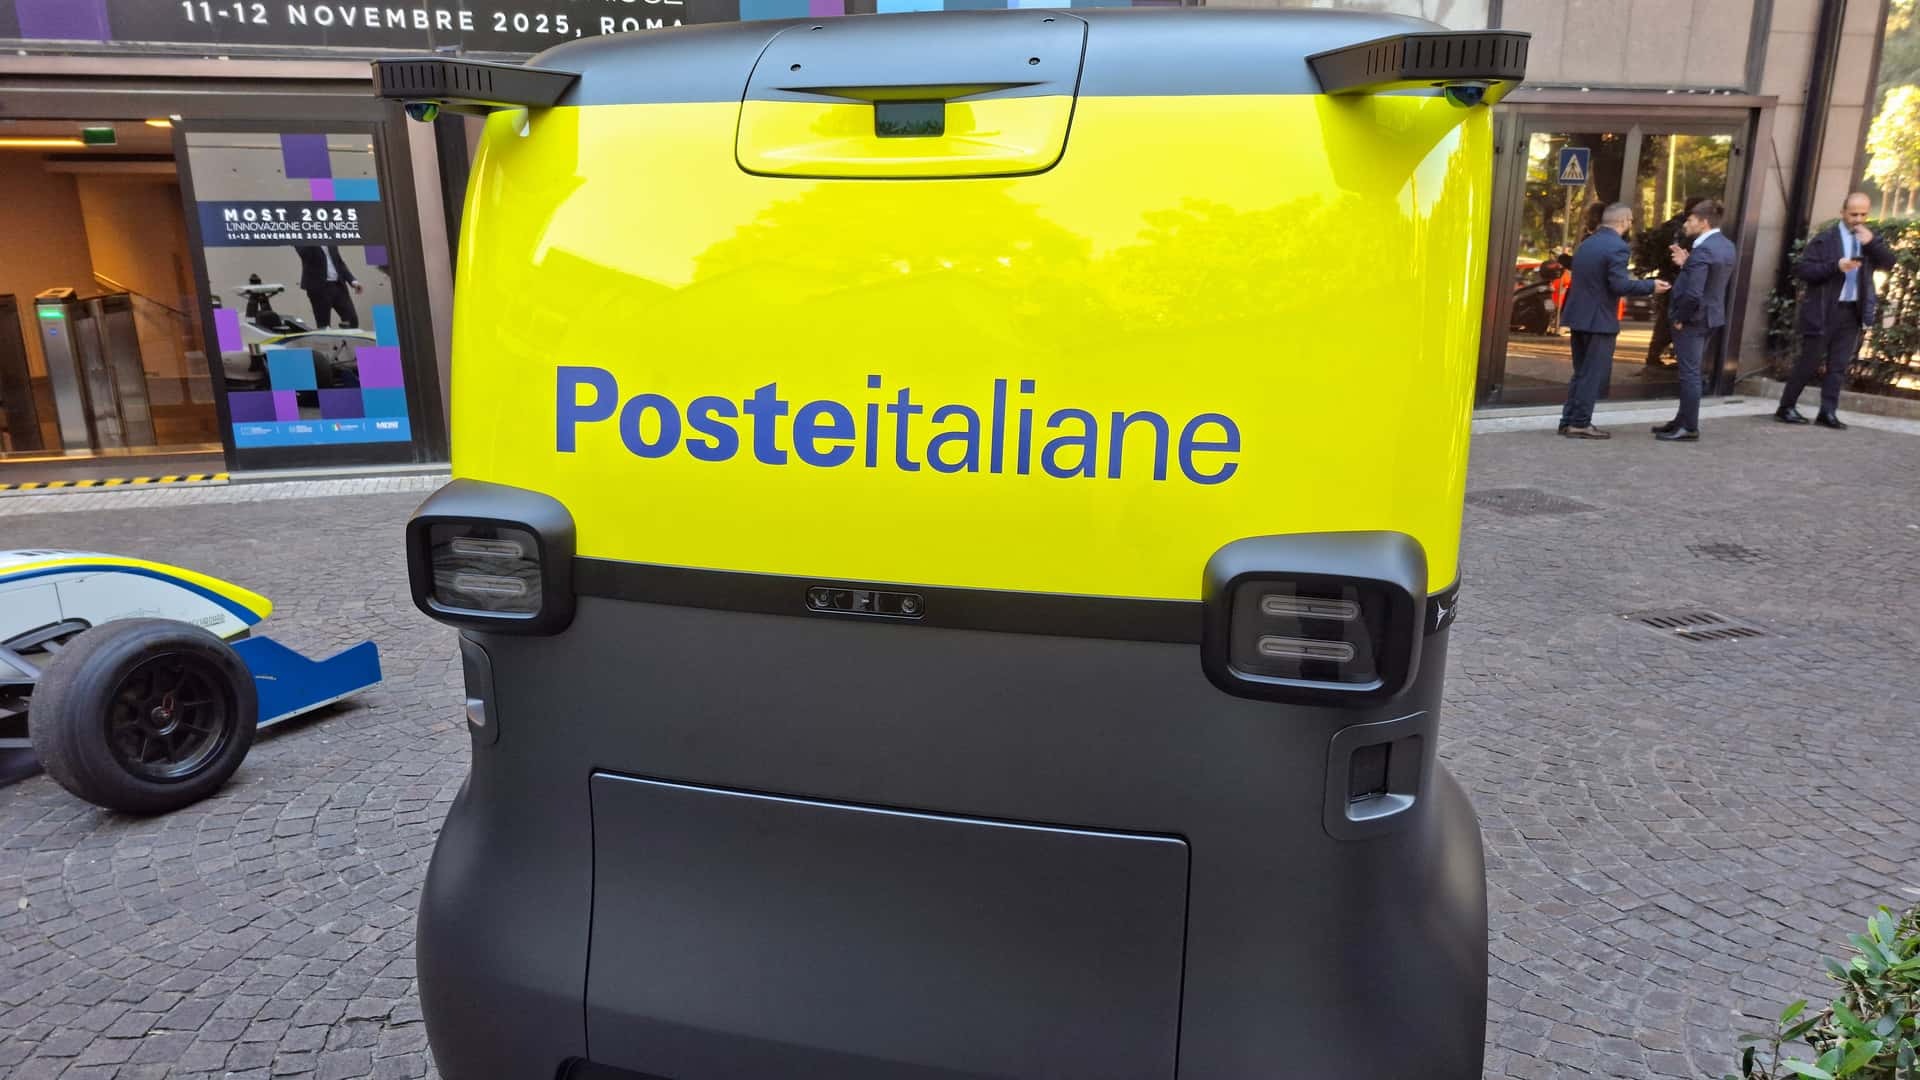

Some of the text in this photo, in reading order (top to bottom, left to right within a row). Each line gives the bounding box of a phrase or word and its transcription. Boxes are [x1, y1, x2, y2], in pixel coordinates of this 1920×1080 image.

[183, 1, 267, 24] 11-12
[288, 4, 474, 31] NOVEMBRE
[492, 11, 583, 37] 2025,
[224, 209, 358, 222] MOST 2025
[226, 222, 360, 232] L'INNOVAZIONE CHE UNISCE
[556, 365, 1242, 486] Posteitaliane
